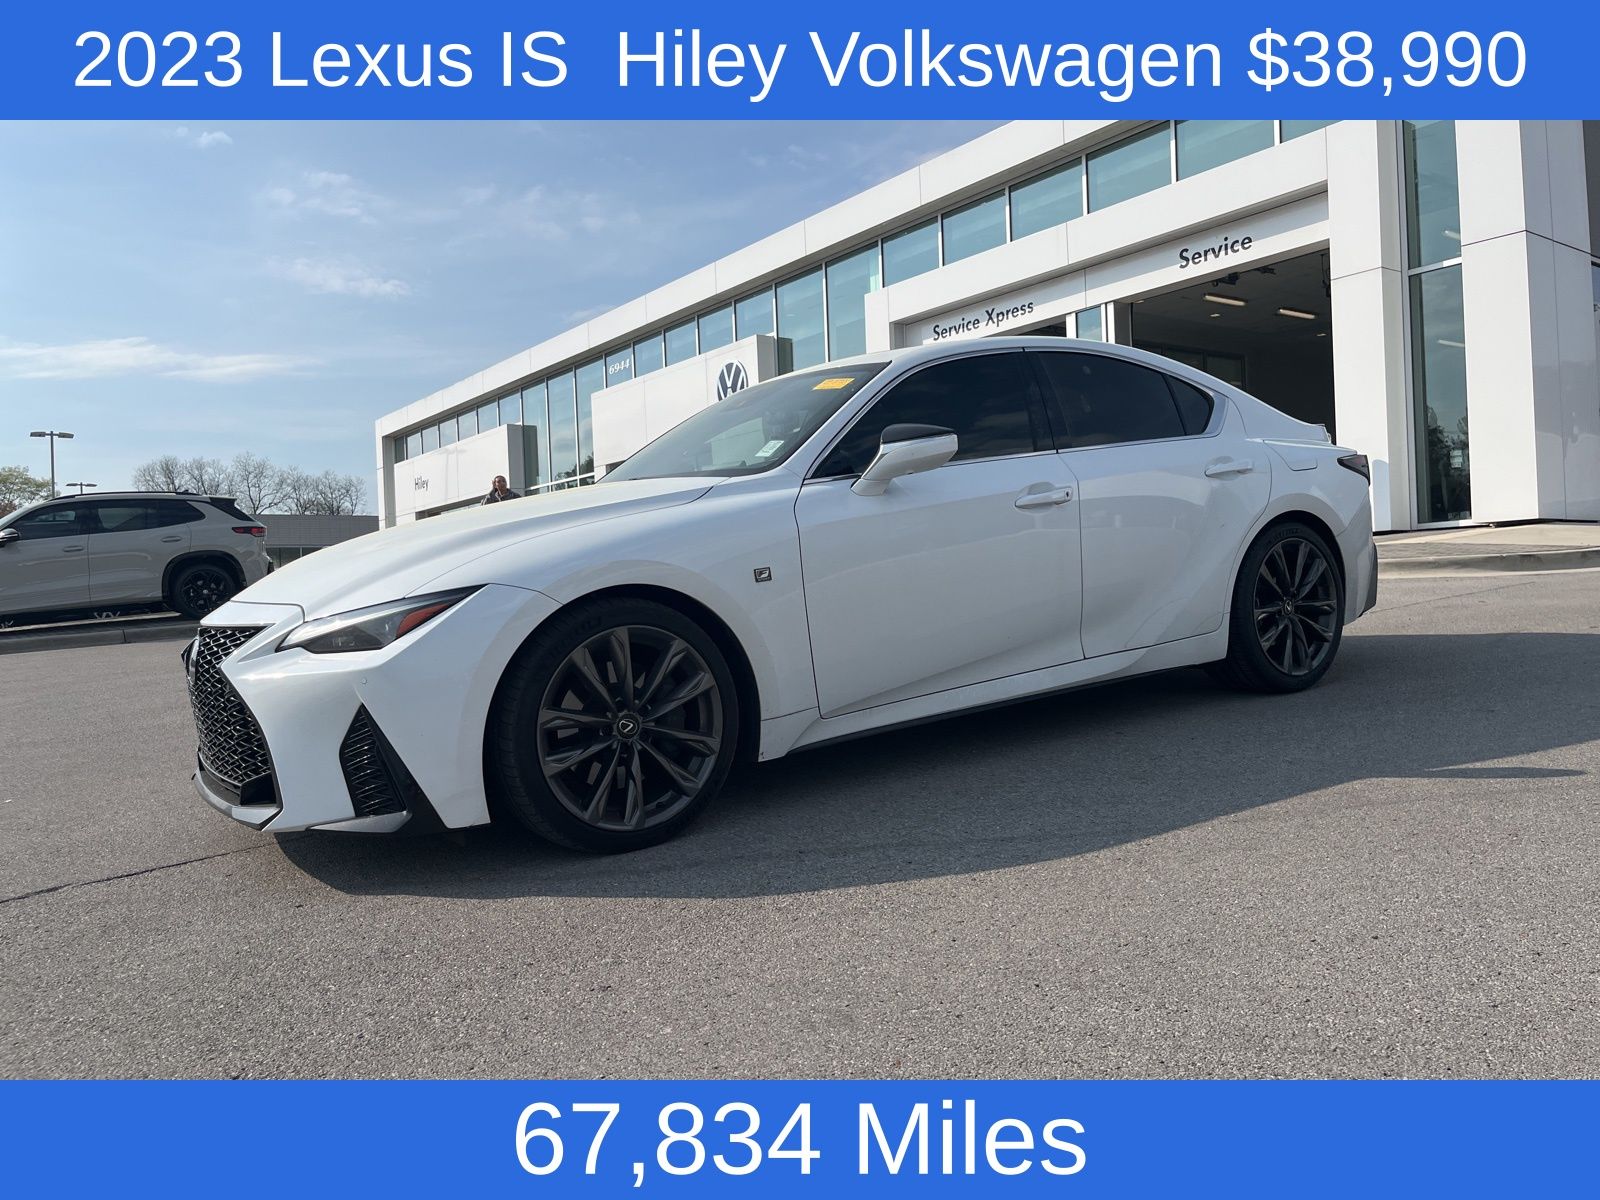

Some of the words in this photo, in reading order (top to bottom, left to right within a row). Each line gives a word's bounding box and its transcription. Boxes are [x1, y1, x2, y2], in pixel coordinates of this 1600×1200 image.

[1178, 235, 1253, 269] Service
[932, 316, 981, 341] Service
[984, 301, 1034, 329] Xpress
[609, 358, 630, 374] 6944
